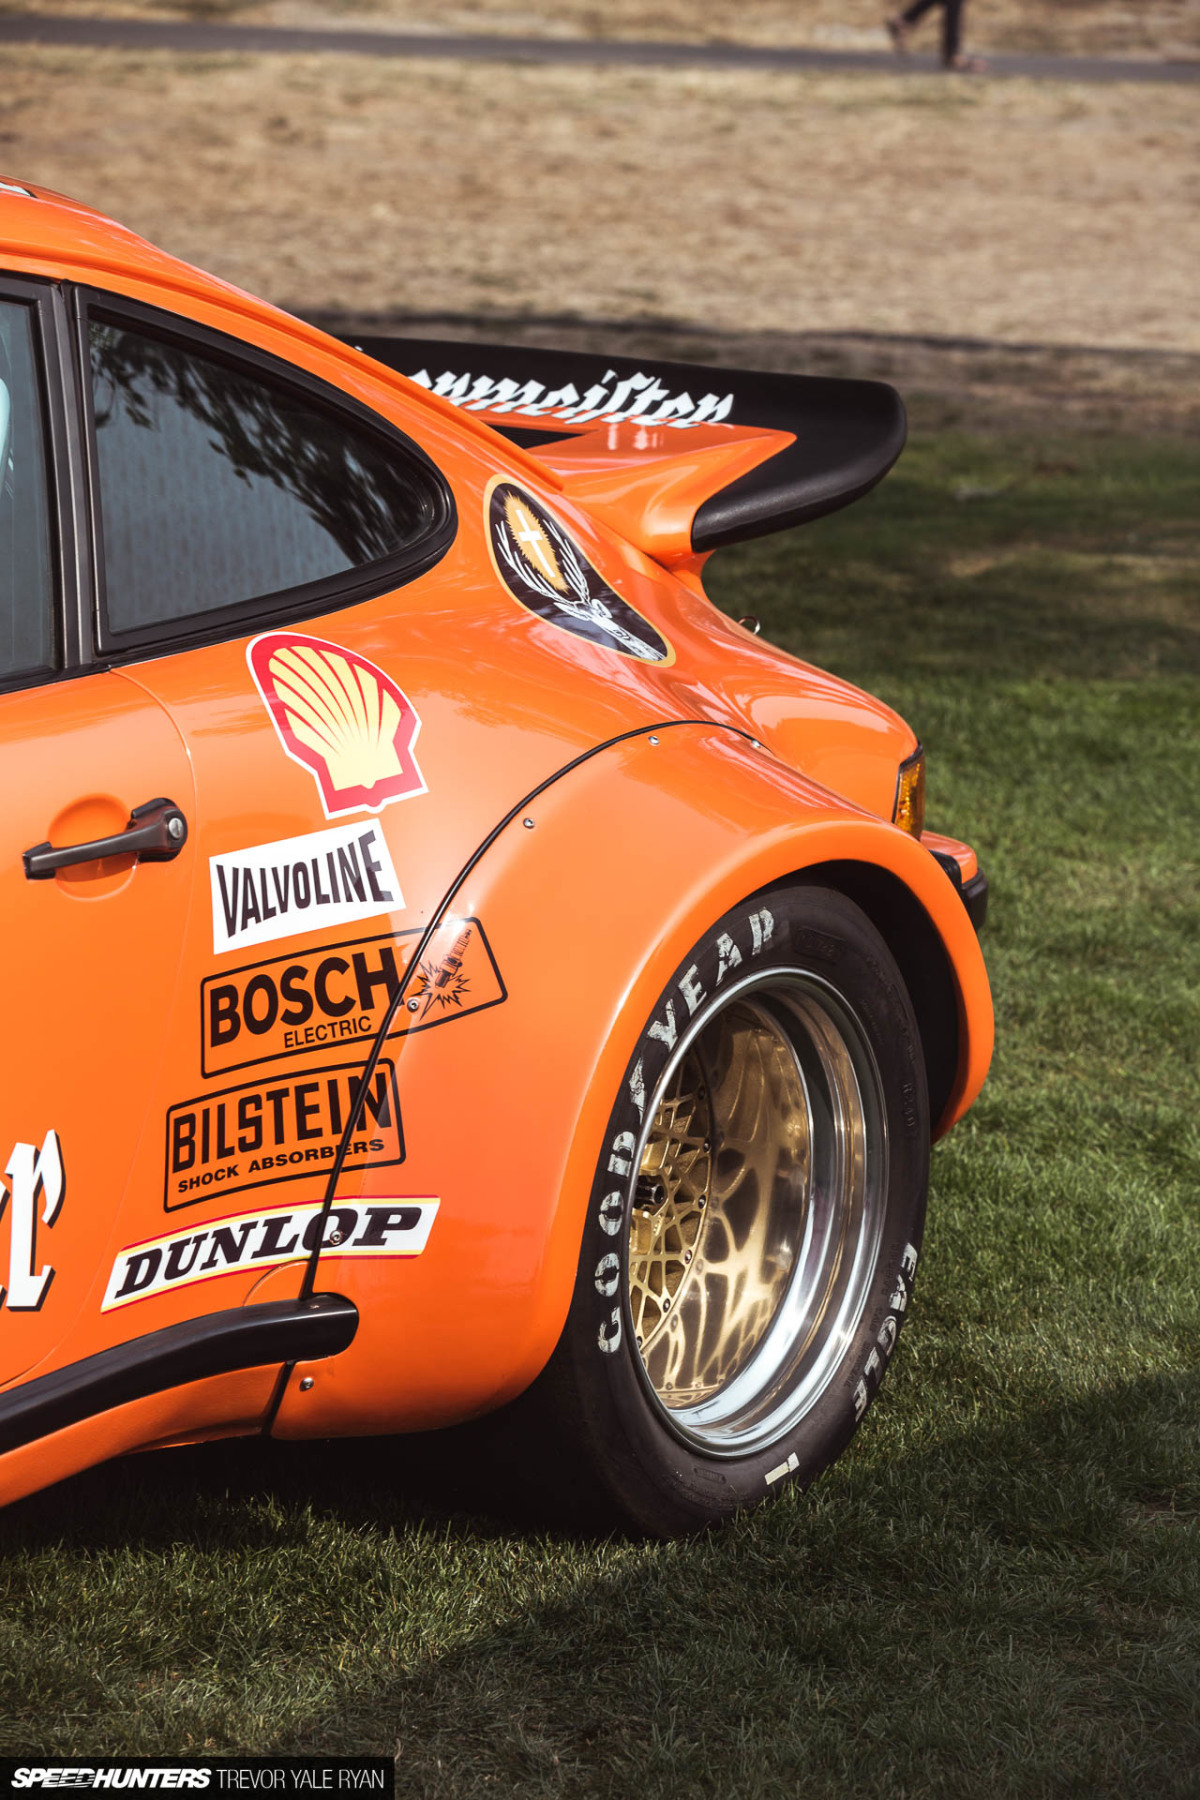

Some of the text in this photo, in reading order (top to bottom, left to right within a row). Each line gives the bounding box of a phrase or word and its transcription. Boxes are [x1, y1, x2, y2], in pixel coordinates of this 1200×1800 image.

[216, 829, 395, 938] VALVOLINE
[209, 946, 405, 1048] BOSCH
[283, 1016, 372, 1048] ELECTRIC
[172, 1072, 392, 1174] BILSTEIN
[177, 1138, 386, 1194] SHOCK ABSORBERS
[594, 907, 775, 1354] GOODYEAR
[114, 1206, 423, 1300] DUNLOP
[853, 1242, 919, 1423] EAGLE
